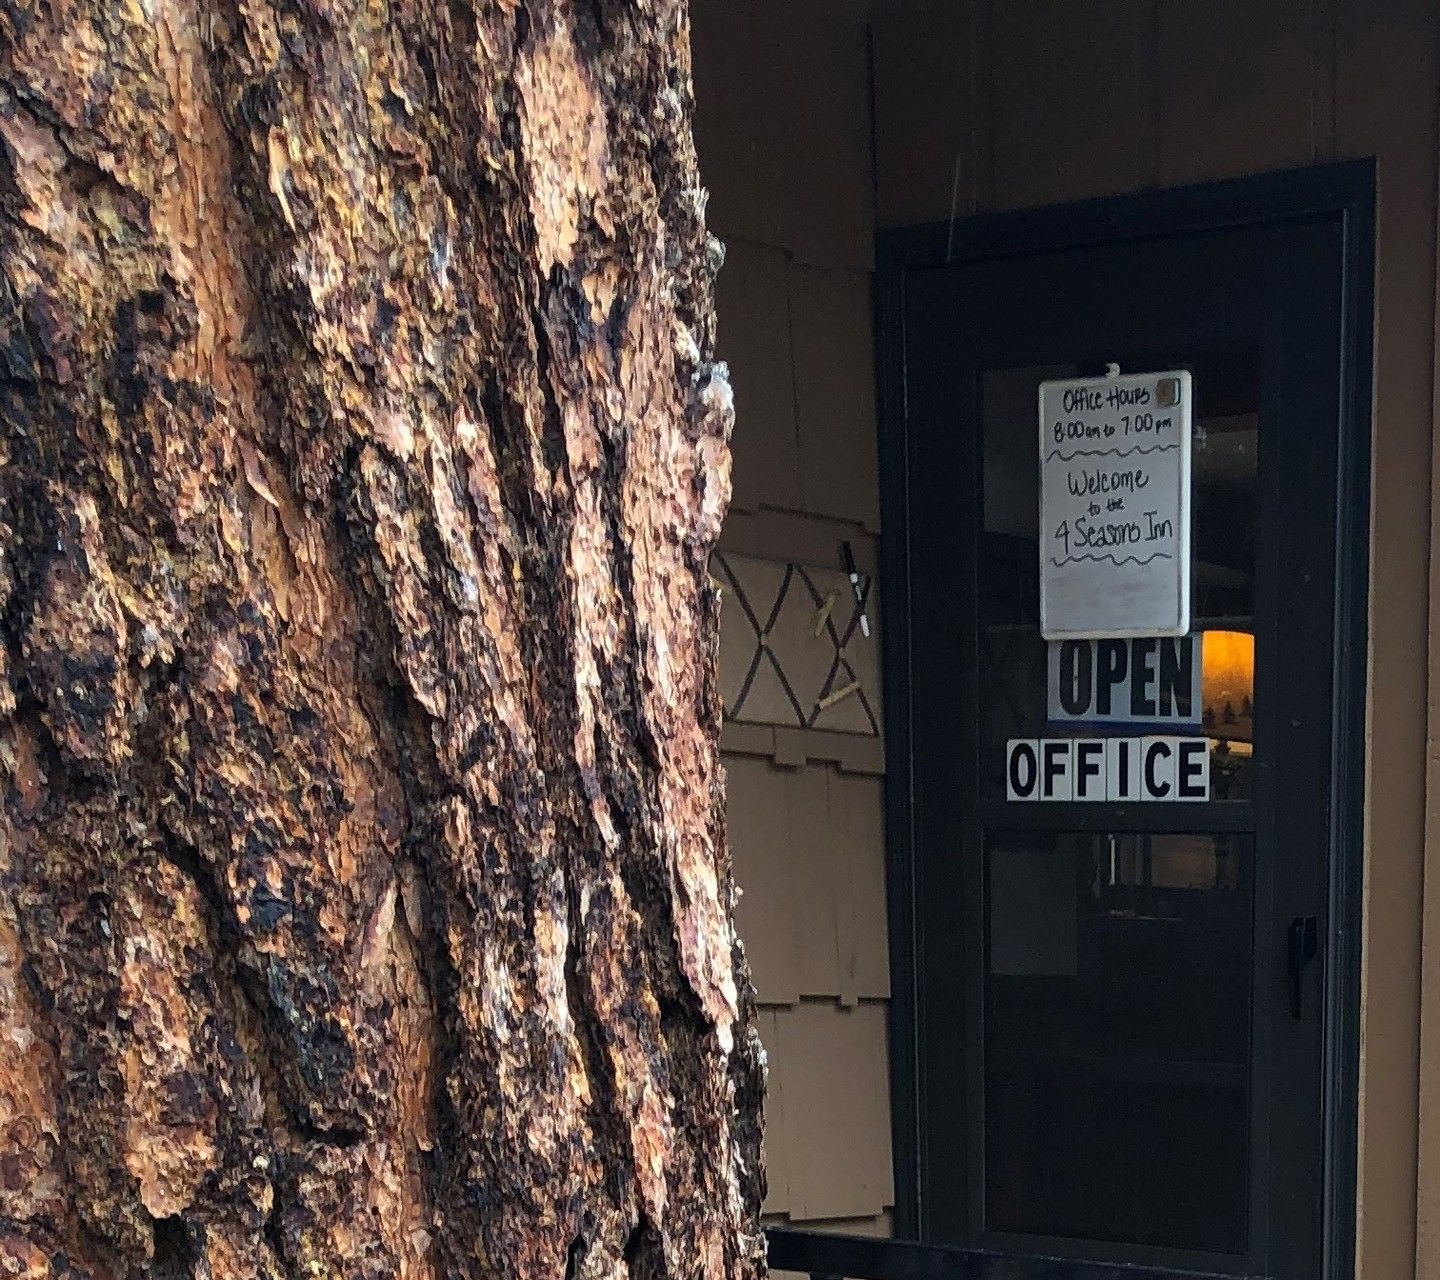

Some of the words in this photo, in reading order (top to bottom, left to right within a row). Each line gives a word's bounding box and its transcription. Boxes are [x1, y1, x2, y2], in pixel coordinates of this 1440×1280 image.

[1063, 386, 1103, 413] Office
[1106, 385, 1151, 411] Hours
[1103, 423, 1115, 437] to
[1155, 417, 1172, 435] pm
[1067, 468, 1149, 496] Welcome
[1087, 501, 1101, 517] to
[1106, 497, 1125, 512] the
[1054, 519, 1070, 555] 4
[1074, 514, 1141, 548] Seasons
[1143, 509, 1173, 541] Inn
[1059, 635, 1192, 718] OPEN
[1009, 741, 1207, 798] OFFICE
